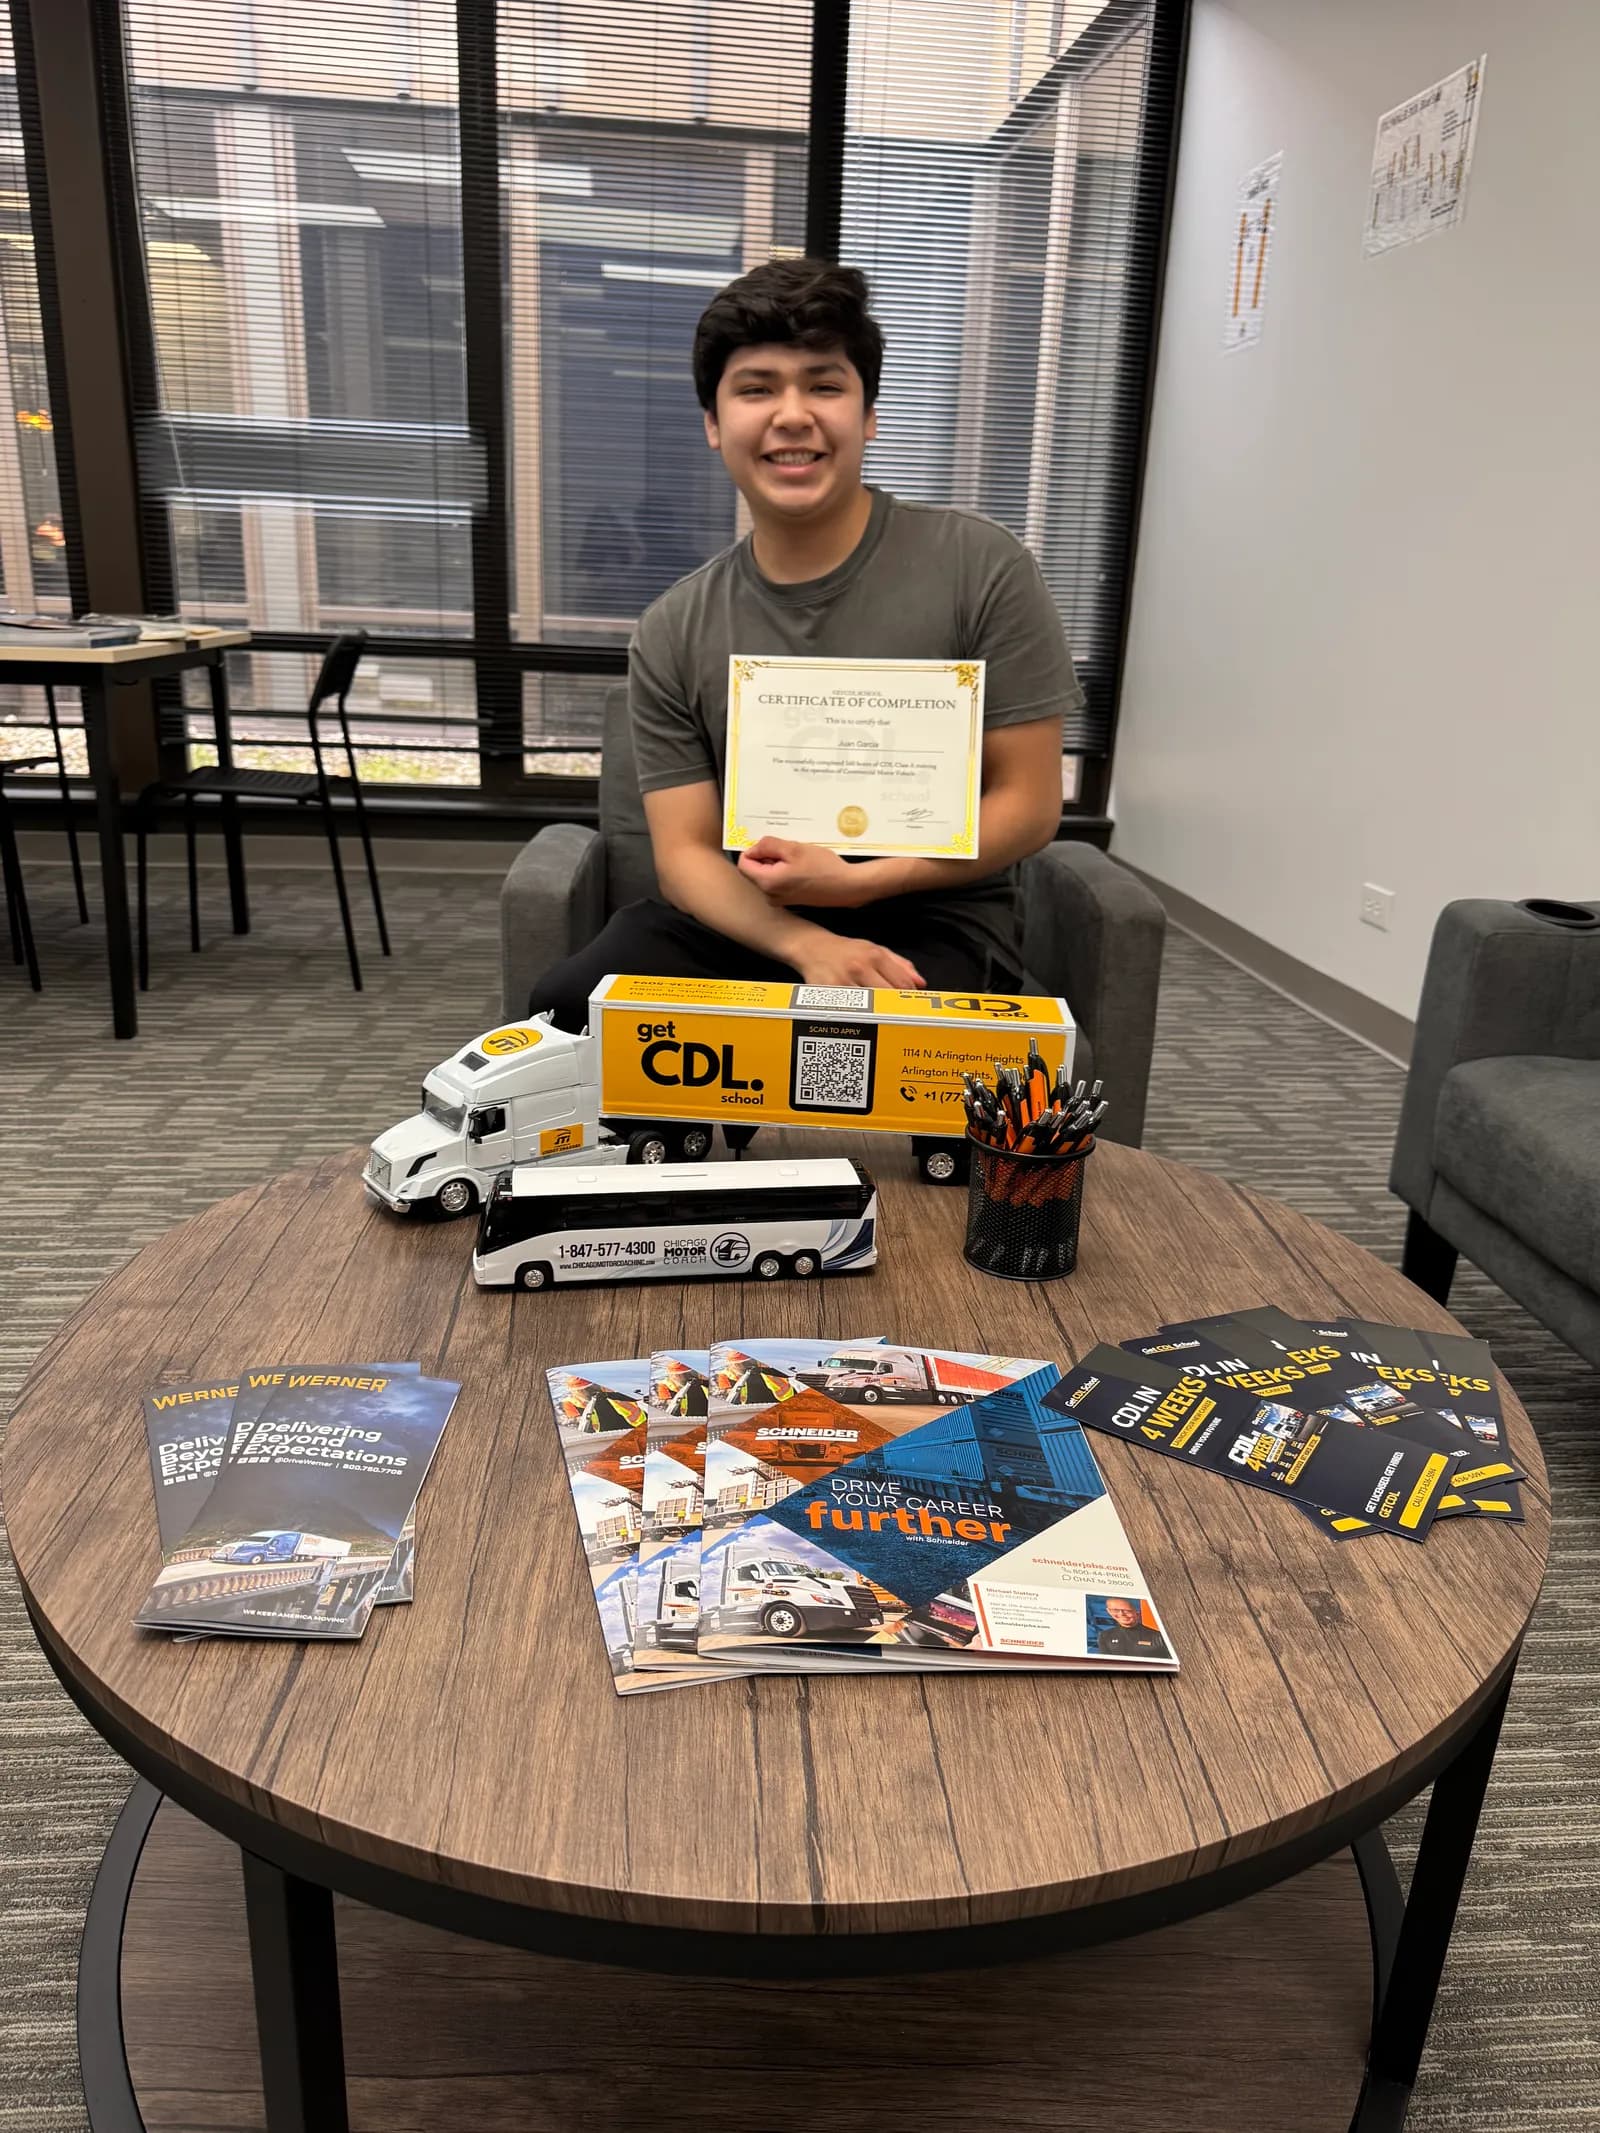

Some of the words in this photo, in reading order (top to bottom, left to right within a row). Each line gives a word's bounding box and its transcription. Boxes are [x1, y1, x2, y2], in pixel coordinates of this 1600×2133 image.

[758, 694, 846, 707] CERTIFICATE
[848, 696, 865, 708] OF
[867, 697, 957, 710] COMPLETION
[855, 718, 876, 727] certify
[837, 740, 855, 748] Juan
[856, 741, 879, 749] Garcia
[900, 994, 1022, 1012] CDL.
[637, 1021, 676, 1042] get
[809, 1026, 828, 1034] SCAN
[829, 1026, 839, 1034] TO
[840, 1027, 861, 1036] APPLY
[902, 1048, 920, 1058] 1114
[923, 1049, 932, 1058] N
[934, 1050, 983, 1065] Arlington
[984, 1053, 1025, 1066] Heights
[641, 1040, 765, 1092] CDL.
[901, 1066, 950, 1080] Arlington
[720, 1092, 764, 1106] school
[924, 1092, 937, 1101] +1
[559, 1240, 656, 1259] 1-847-577-4300
[663, 1238, 708, 1248] CHICAGO
[664, 1246, 707, 1257] MOTOR
[663, 1256, 707, 1265] COACH
[1286, 1344, 1342, 1365] EKS
[1216, 1358, 1251, 1373] IN
[1374, 1366, 1436, 1382] EKS
[288, 1375, 388, 1392] WERNER
[152, 1386, 240, 1410] WERNE
[1065, 1396, 1078, 1408] Get
[1072, 1388, 1084, 1402] CDL
[1080, 1376, 1099, 1391] School
[1111, 1401, 1150, 1428] CDL
[1132, 1385, 1162, 1405] IN
[1146, 1376, 1208, 1428] WEEKS
[249, 1432, 347, 1448] Beyond
[256, 1421, 382, 1443] Delivering
[756, 1427, 859, 1439] SCHNEIDER
[1140, 1425, 1166, 1441] 4
[158, 1436, 227, 1456] Deliv
[1250, 1433, 1276, 1461] WEEKS
[160, 1447, 224, 1466] Beyo
[242, 1443, 408, 1467] Expectations
[274, 1456, 333, 1467] @DriveWerner
[1246, 1456, 1268, 1472] 4
[831, 1478, 901, 1495] DRIVE
[830, 1492, 900, 1509] YOUR
[906, 1496, 1004, 1518] CAREER
[1412, 1494, 1424, 1508] CALL
[804, 1500, 1012, 1543] further
[905, 1535, 924, 1543] with
[926, 1536, 970, 1546] Schneider
[1032, 1557, 1129, 1572] schneiderjobs.com
[1072, 1568, 1132, 1580] 800-44-PRIDE
[1072, 1576, 1095, 1584] CHAT
[1108, 1578, 1135, 1588] 28000
[278, 1612, 312, 1621] AMERICA
[314, 1615, 345, 1624] MOVING
